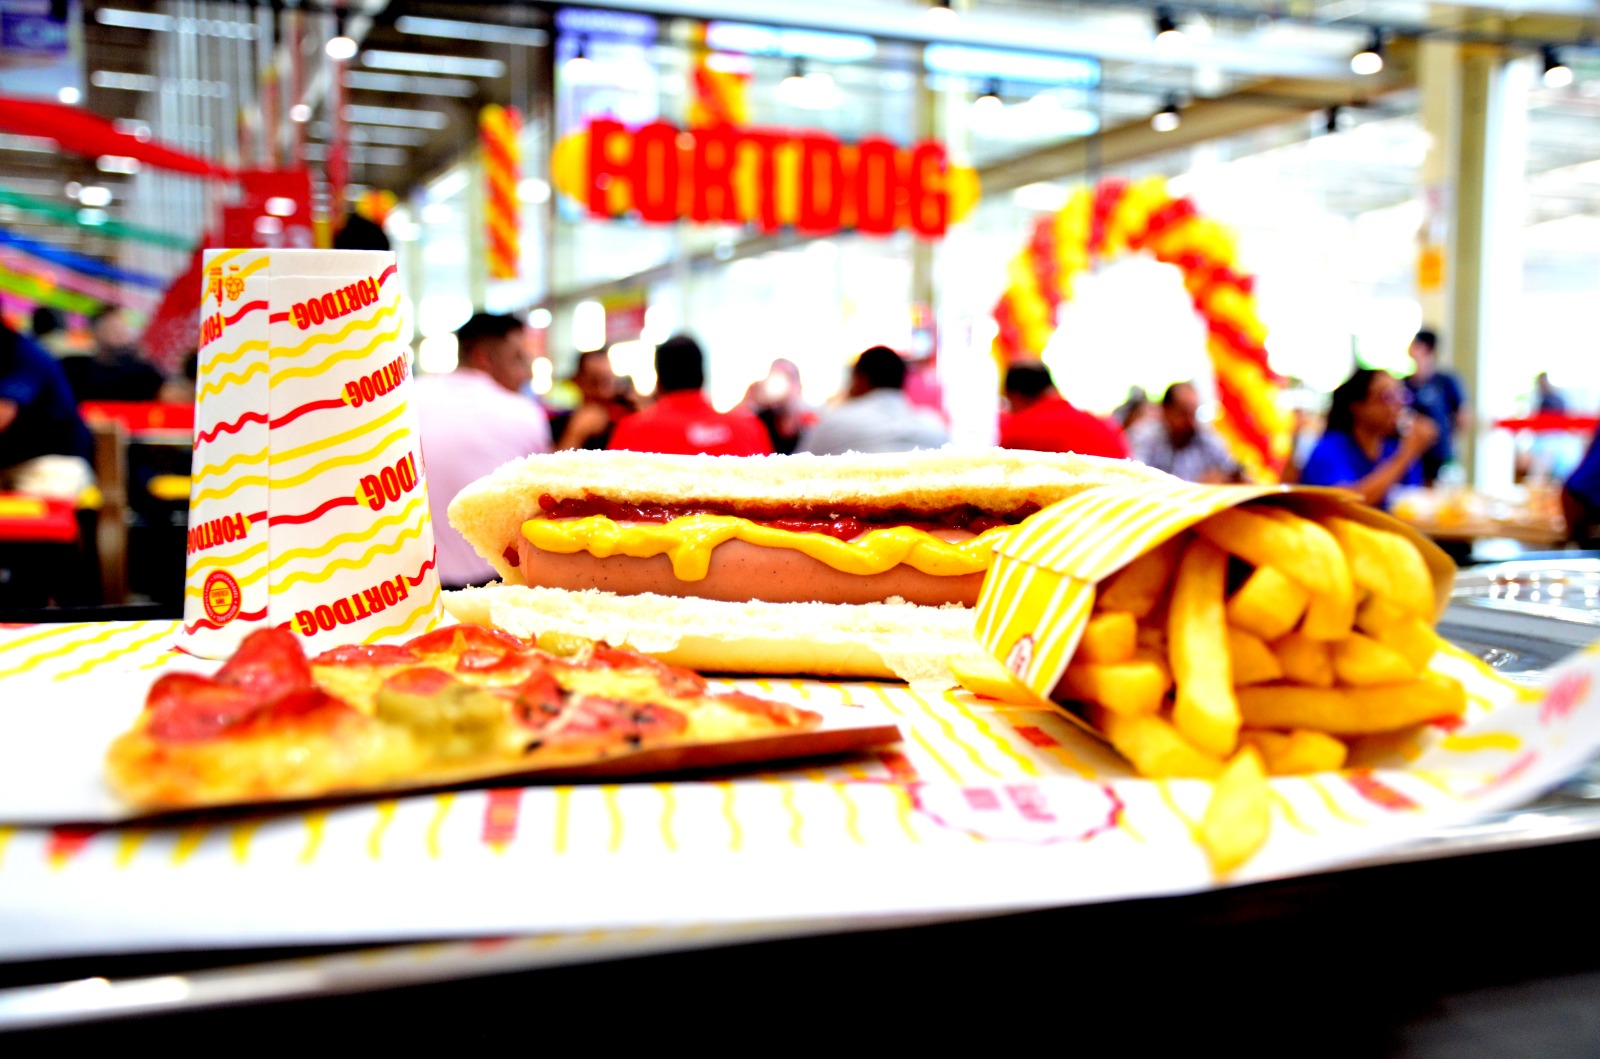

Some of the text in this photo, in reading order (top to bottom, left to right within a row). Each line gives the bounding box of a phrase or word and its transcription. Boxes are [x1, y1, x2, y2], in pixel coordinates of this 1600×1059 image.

[587, 118, 947, 239] FORTDOG
[199, 312, 223, 350] FOR
[291, 276, 379, 330] FORTDOG
[295, 574, 409, 637] FORTDOG
